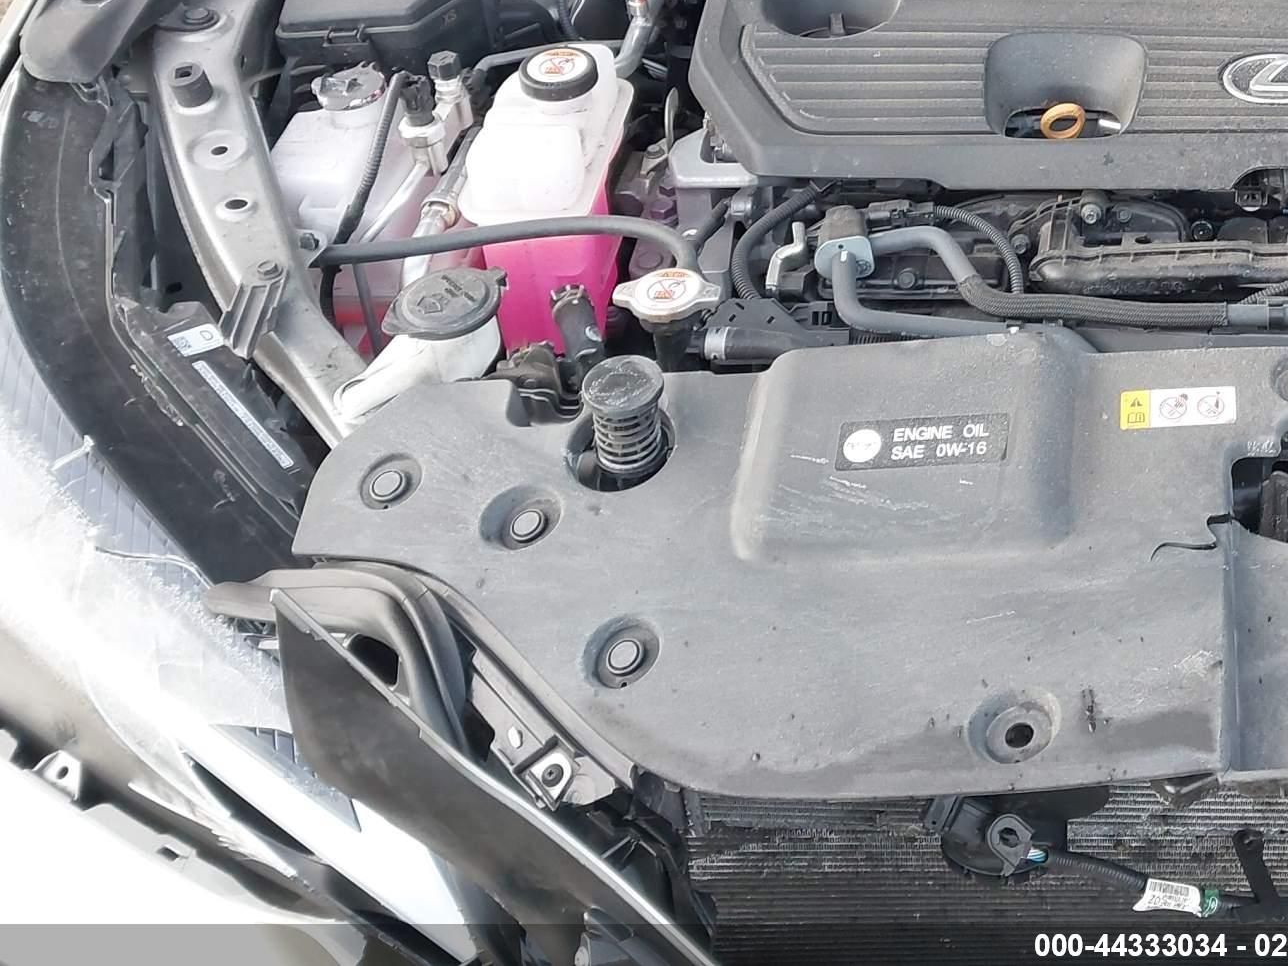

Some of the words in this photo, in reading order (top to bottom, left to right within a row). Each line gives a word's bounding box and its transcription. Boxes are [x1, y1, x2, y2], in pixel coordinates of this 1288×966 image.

[893, 425, 953, 442] ENGINE
[963, 424, 989, 438] OIL
[891, 445, 924, 460] SAE
[936, 441, 987, 457] 0W-16
